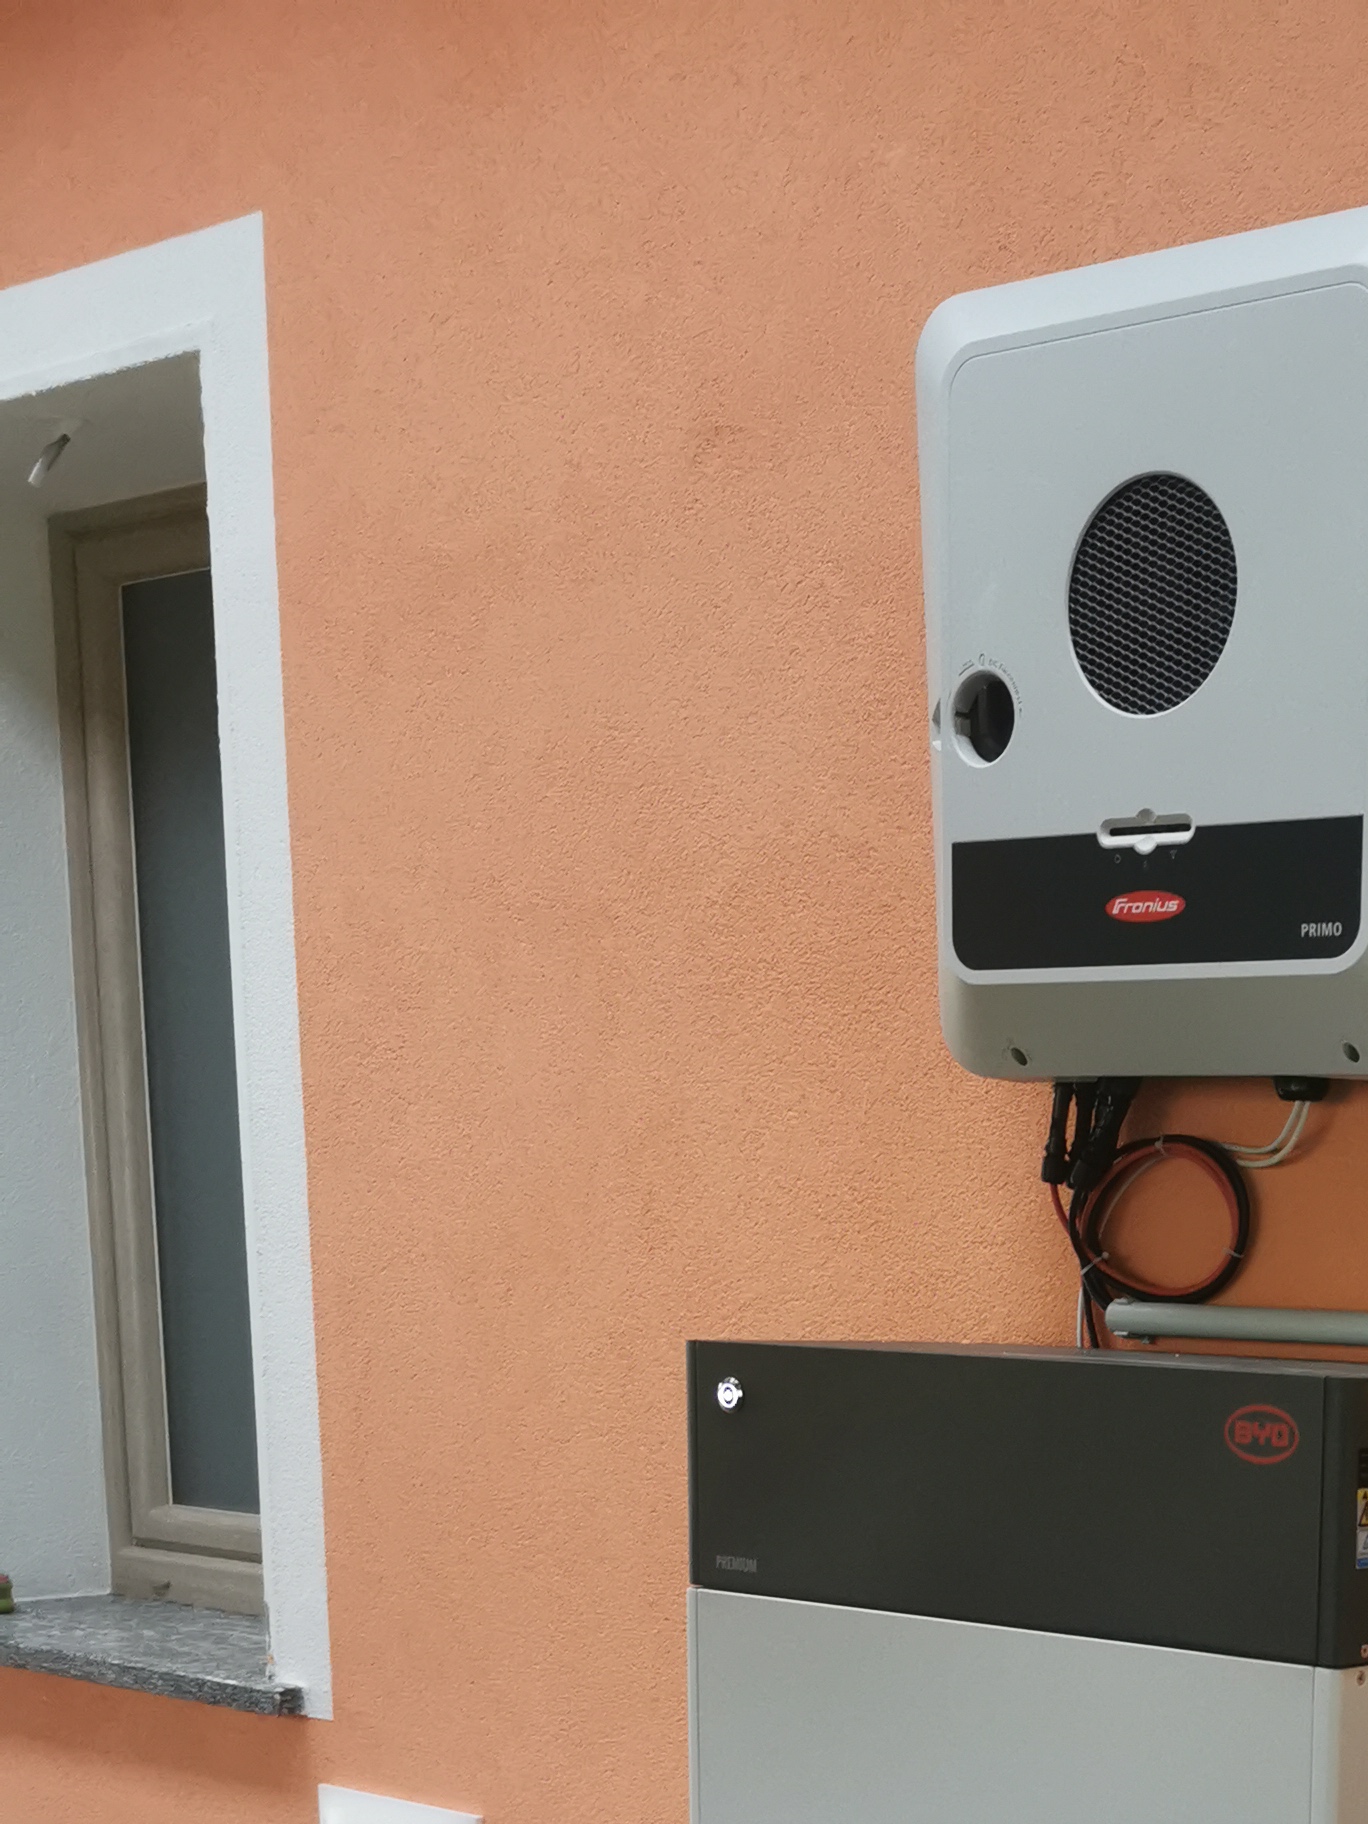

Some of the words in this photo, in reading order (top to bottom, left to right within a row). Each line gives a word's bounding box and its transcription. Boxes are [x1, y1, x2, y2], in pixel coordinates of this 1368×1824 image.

[1111, 897, 1181, 915] Fronius
[1300, 921, 1343, 938] PRIMO
[1234, 1420, 1289, 1447] BYD
